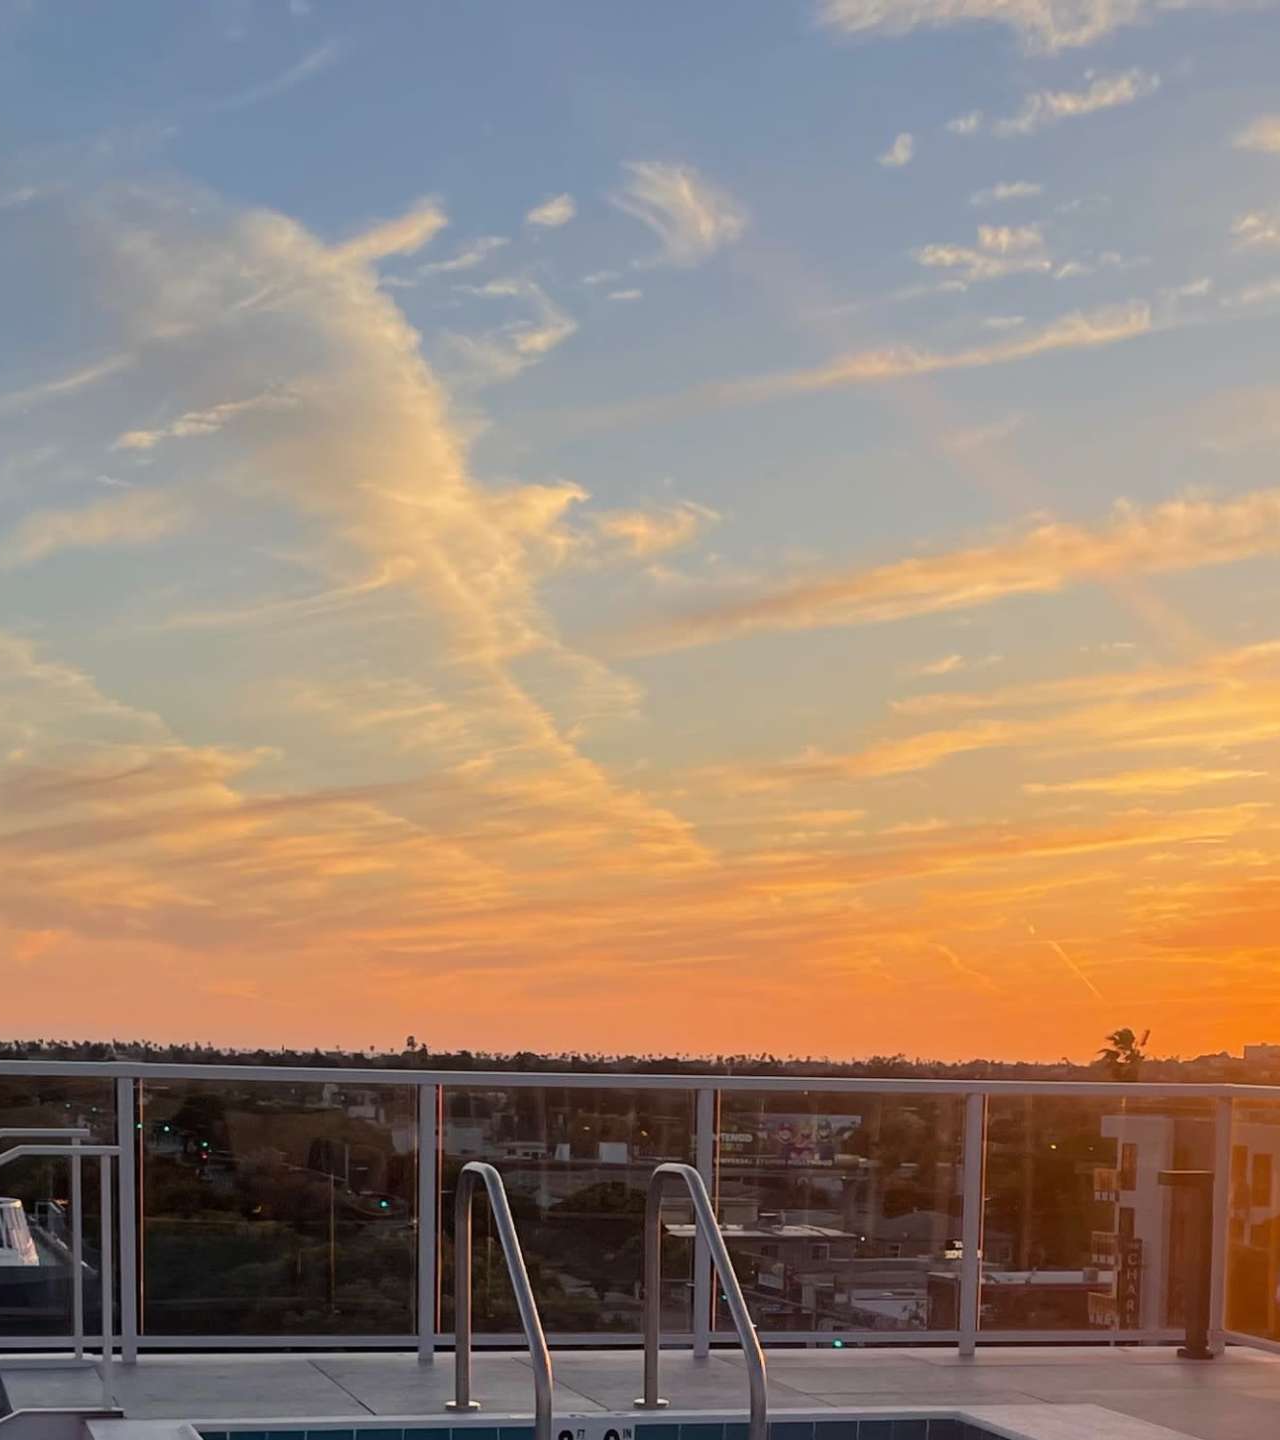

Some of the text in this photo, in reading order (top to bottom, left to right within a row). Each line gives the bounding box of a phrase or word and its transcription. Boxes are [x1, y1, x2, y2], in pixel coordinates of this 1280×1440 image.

[1125, 1253, 1138, 1328] CHARL
[577, 1429, 585, 1440] FT
[623, 1428, 632, 1439] IN
